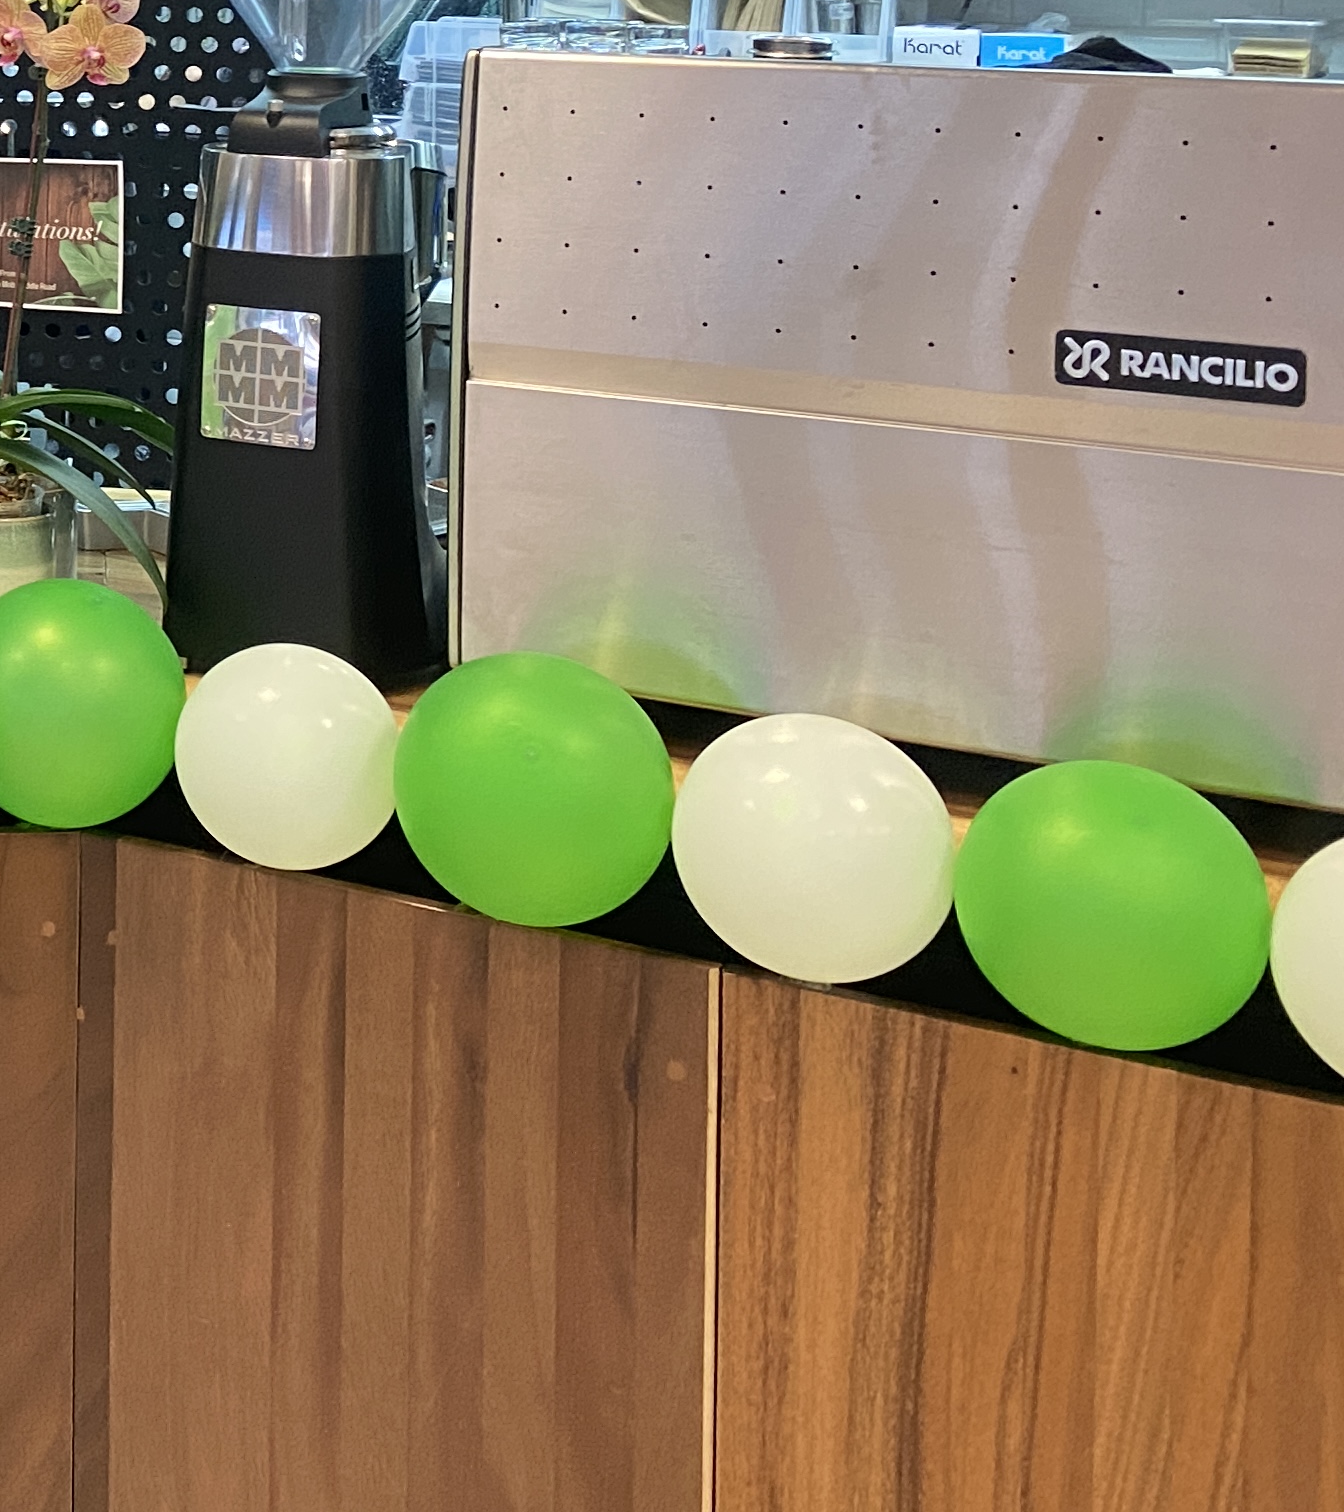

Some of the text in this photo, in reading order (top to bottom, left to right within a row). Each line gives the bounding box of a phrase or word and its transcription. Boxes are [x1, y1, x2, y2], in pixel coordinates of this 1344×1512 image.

[903, 38, 962, 55] Karat
[997, 45, 1046, 61] Karat
[1120, 348, 1299, 392] RANCILIO
[215, 426, 300, 446] MAZZER
